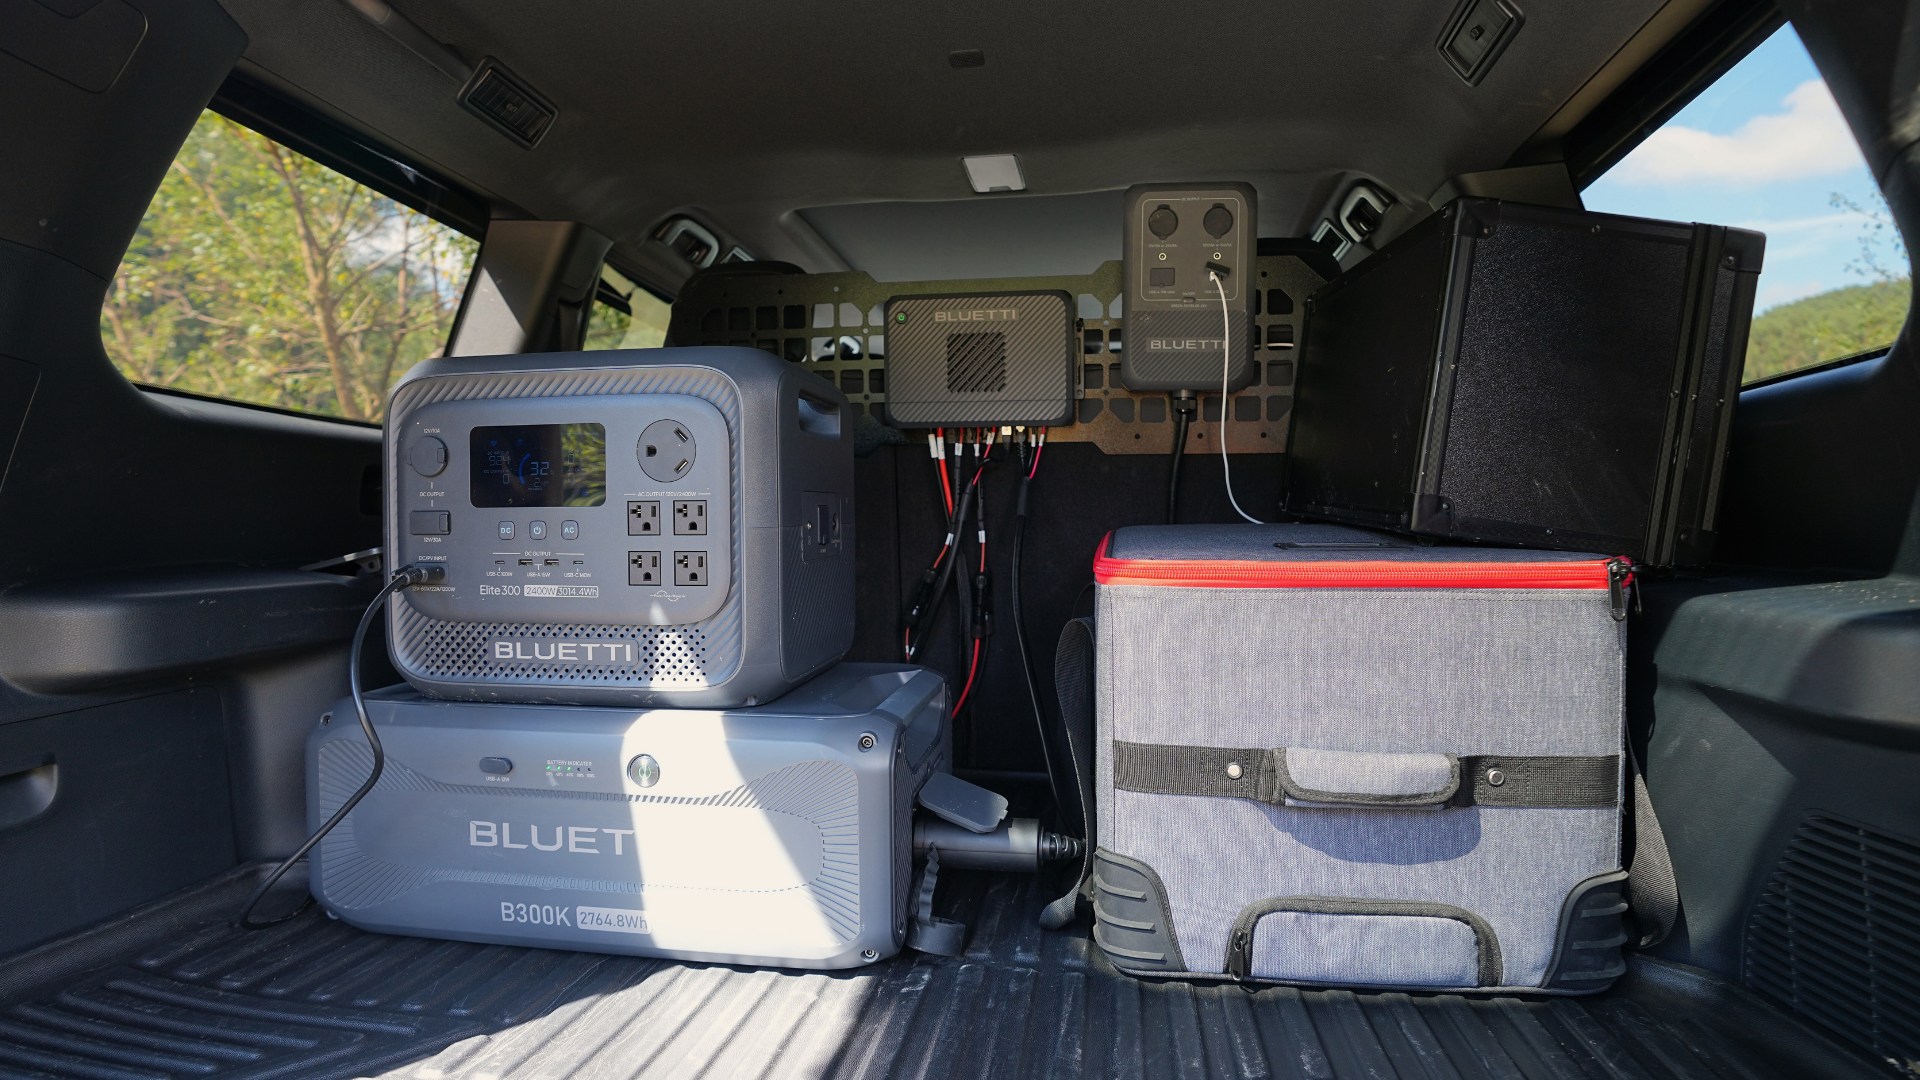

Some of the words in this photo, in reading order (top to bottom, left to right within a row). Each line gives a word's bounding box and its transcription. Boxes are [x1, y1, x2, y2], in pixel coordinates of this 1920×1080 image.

[934, 309, 1016, 322] BLUETTI
[530, 461, 550, 476] 32
[564, 526, 575, 534] AC
[526, 586, 556, 596] 2400W
[494, 641, 632, 662] BLUETTI
[470, 820, 635, 856] BLUET
[501, 901, 571, 927] B300K
[579, 911, 648, 930] 2764.8Wh
